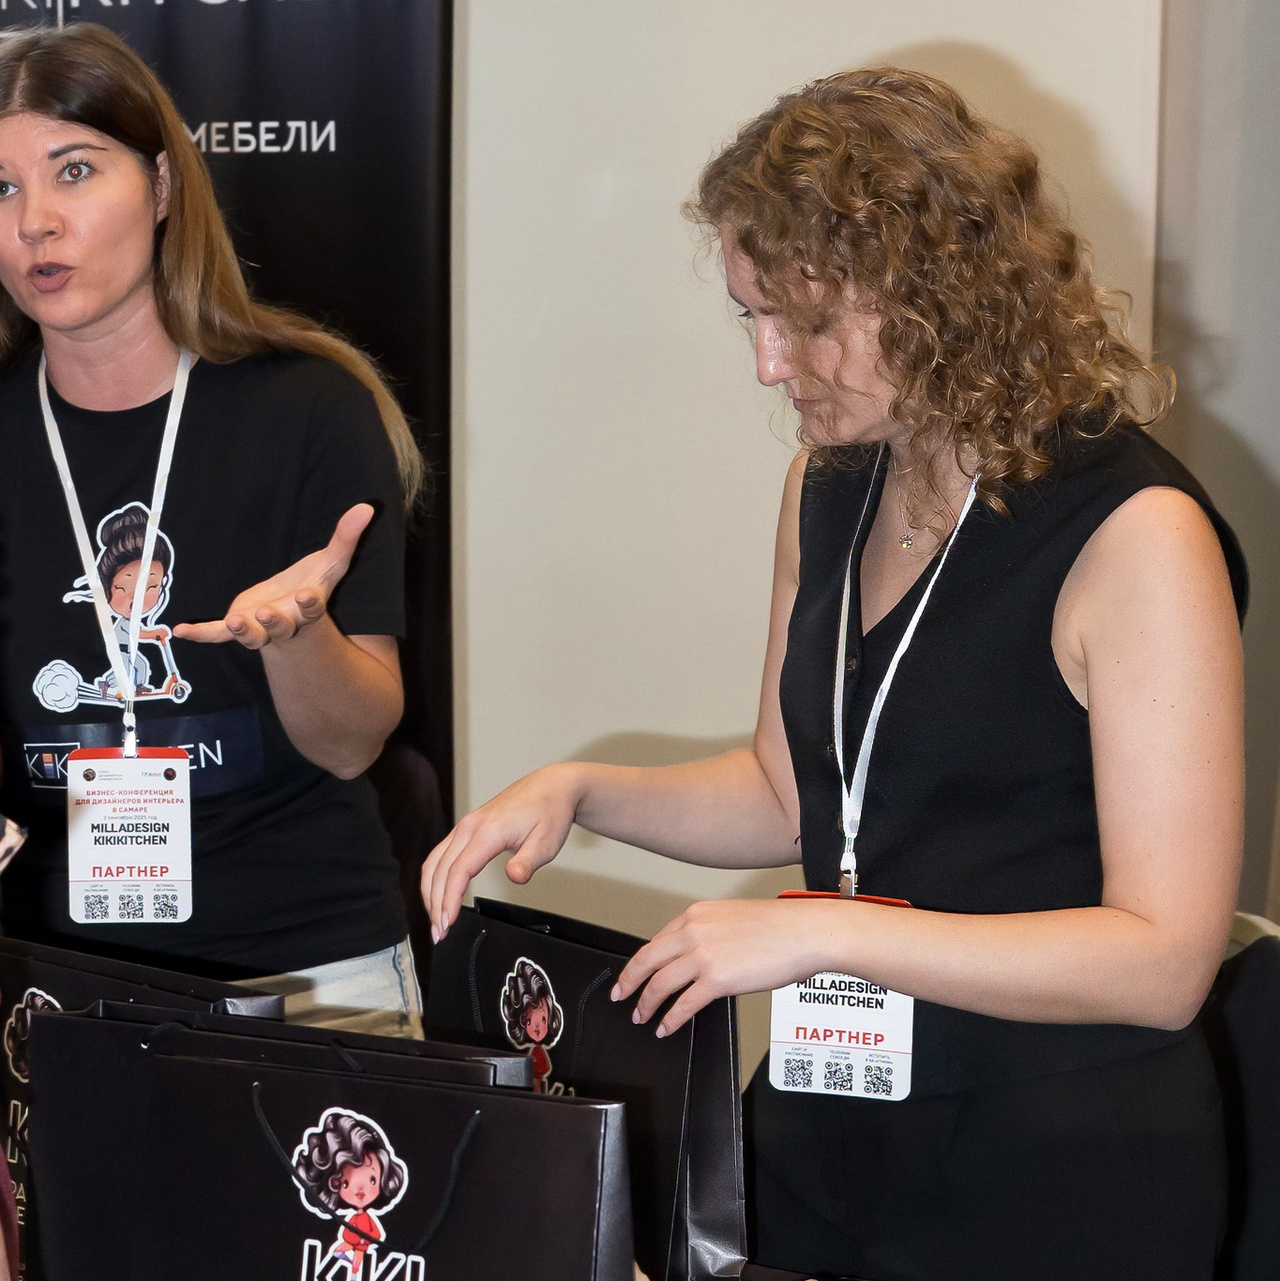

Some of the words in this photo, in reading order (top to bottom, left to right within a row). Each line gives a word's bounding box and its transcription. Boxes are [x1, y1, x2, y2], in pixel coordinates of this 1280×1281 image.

[25, 752, 69, 780] KIK
[86, 789, 174, 797] БИЗНЕС-КОНФЕРЕНЦИЯ
[92, 797, 142, 806] ДИЗАЙНЕРОВ
[143, 797, 185, 805] ИНТЕРЬЕРА
[90, 822, 170, 834] MILLADESIGN
[94, 835, 167, 846] KIKIKITCHEN
[92, 865, 170, 878] ПАРТНЕР
[796, 978, 888, 996] MILLADESIGN
[799, 992, 885, 1010] KIKIKITCHEN
[795, 1026, 885, 1047] ПАРТНЕР
